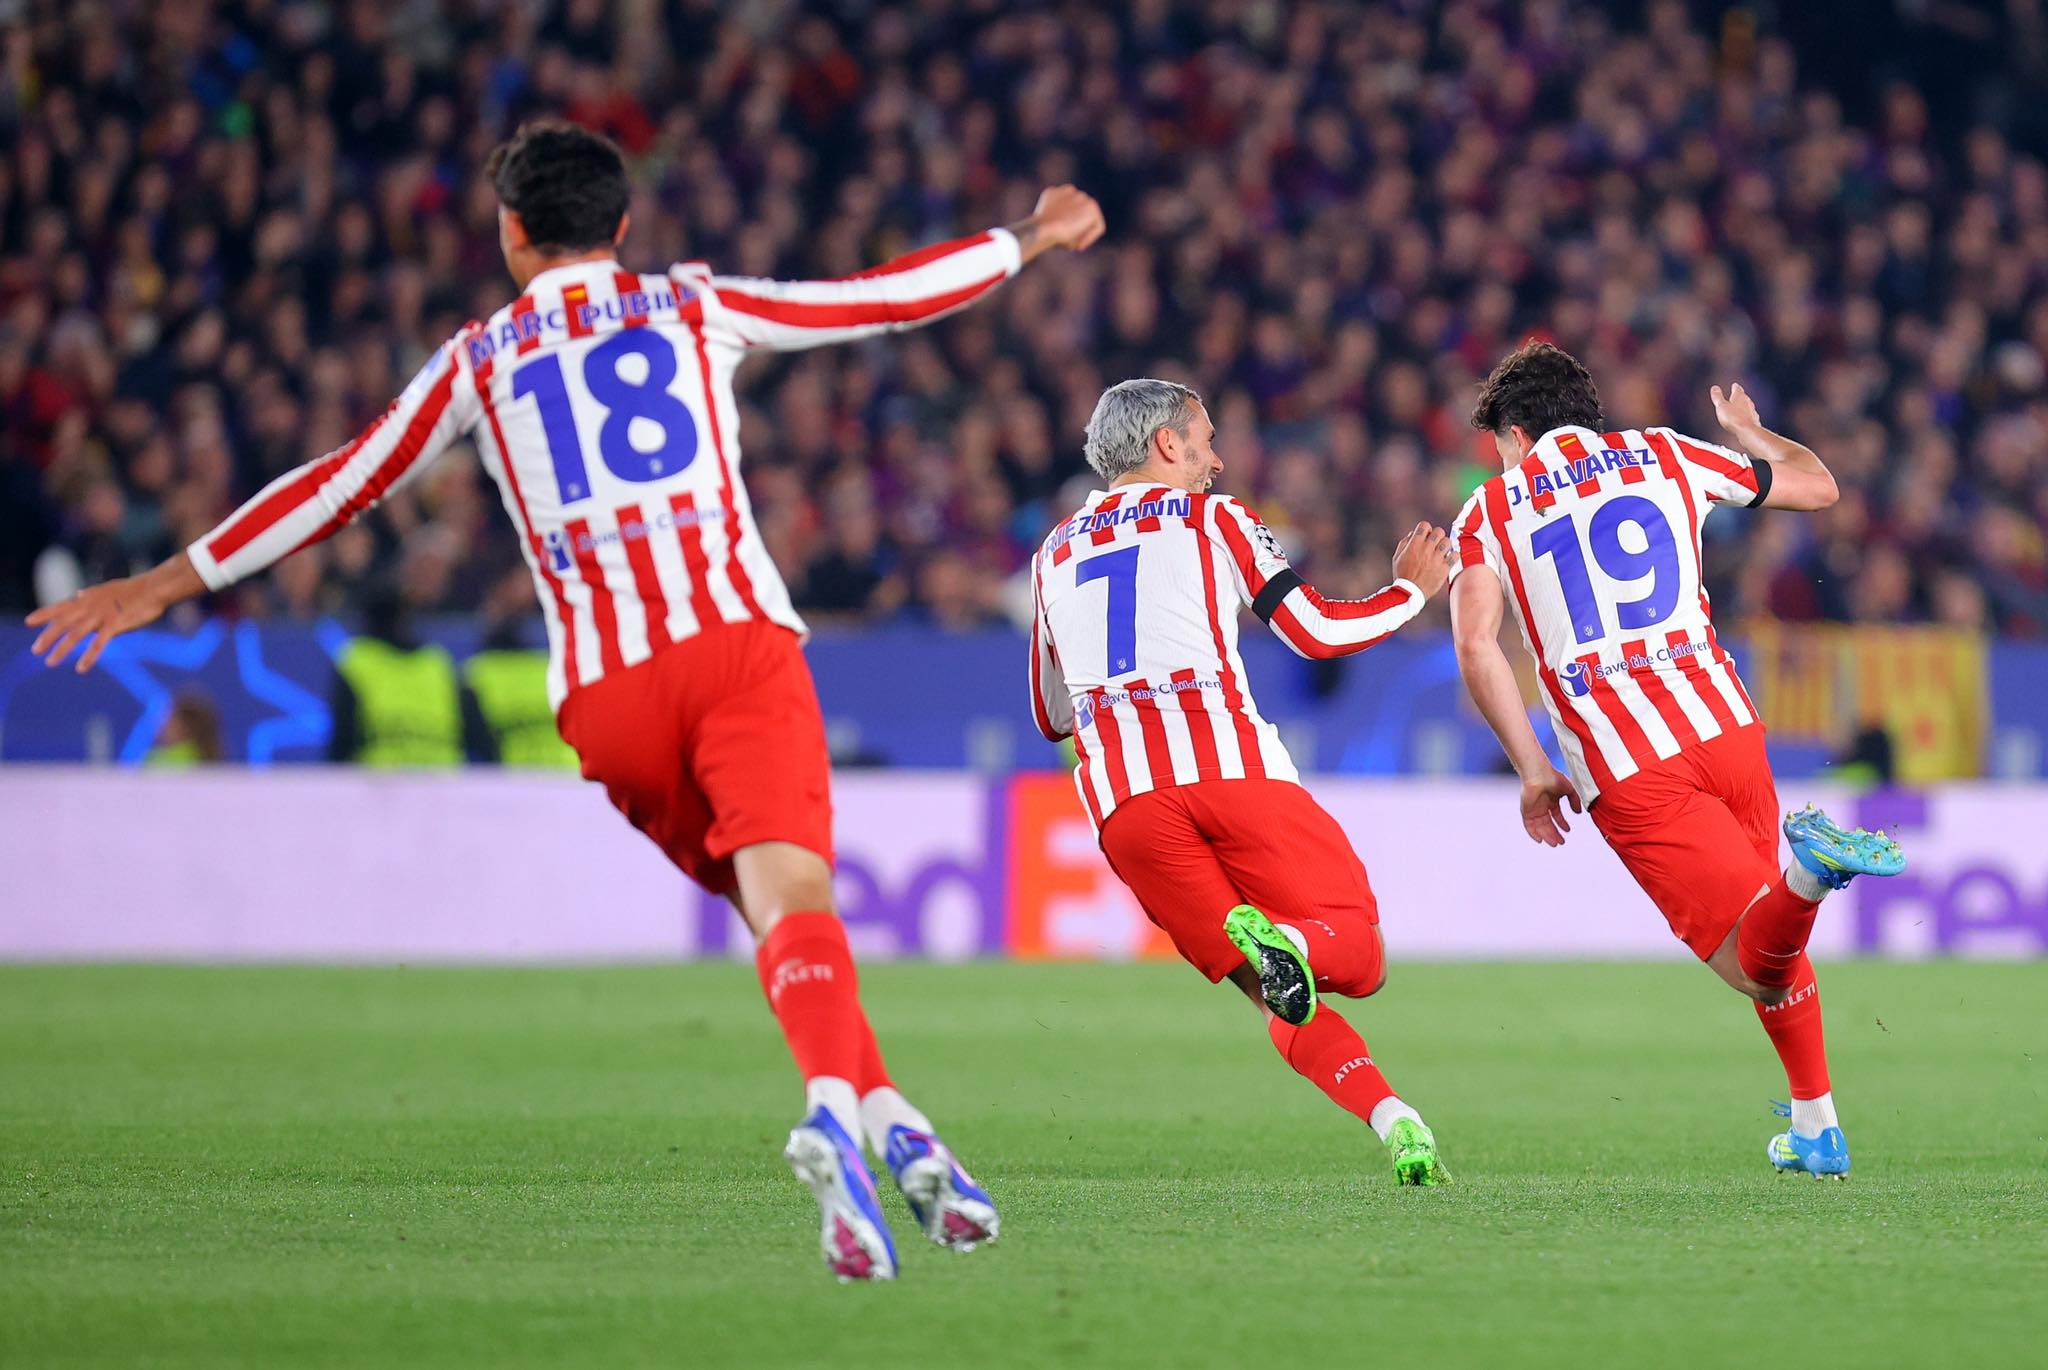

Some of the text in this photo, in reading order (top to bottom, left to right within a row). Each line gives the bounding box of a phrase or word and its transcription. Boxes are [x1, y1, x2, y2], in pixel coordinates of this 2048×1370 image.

[469, 308, 565, 369] MARC
[512, 326, 698, 505] 18
[1508, 448, 1657, 506] J. ALVAREZ
[1530, 495, 1680, 645] 19
[1076, 544, 1141, 679] 7
[1594, 641, 1711, 680] Save the Children
[1099, 678, 1222, 709] Save the Children
